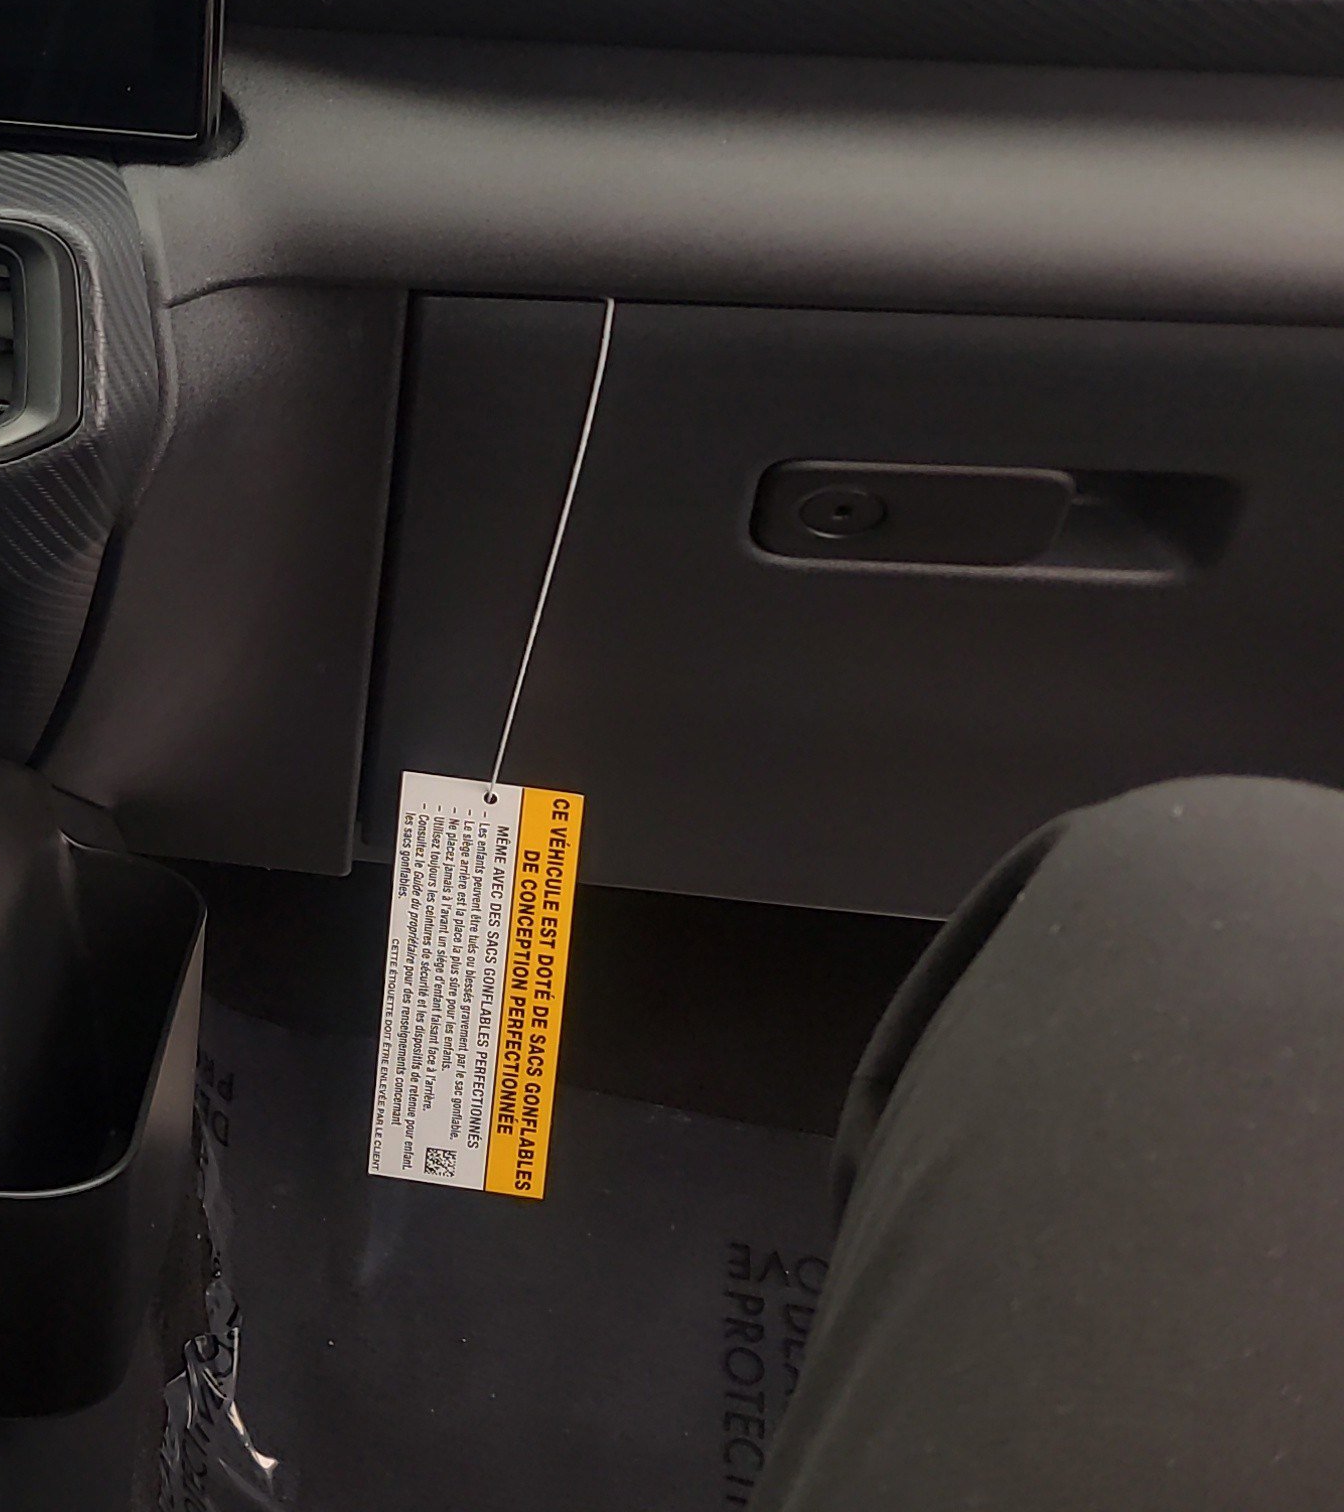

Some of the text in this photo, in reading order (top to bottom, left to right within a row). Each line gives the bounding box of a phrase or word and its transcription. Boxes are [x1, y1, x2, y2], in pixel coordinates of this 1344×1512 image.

[415, 814, 429, 857] Consultez
[431, 816, 444, 849] Utilisez
[459, 833, 473, 857] siège
[477, 822, 490, 838] Les
[397, 812, 416, 898] les sacs gonflables.
[445, 832, 457, 861] placez
[474, 840, 487, 874] enfants
[411, 870, 424, 896] Guide
[427, 851, 441, 887] toujours
[442, 862, 455, 893] jamais
[457, 859, 470, 889] arrière
[426, 889, 438, 902] les
[456, 891, 466, 906] est
[470, 875, 482, 911] peuvent
[422, 904, 435, 945] ceintures
[438, 903, 452, 933] l'avant
[452, 918, 465, 942] place
[469, 914, 481, 932] être
[405, 910, 419, 964] propriétaire
[467, 934, 479, 954] tués
[402, 964, 413, 986] pour
[449, 955, 462, 974] plus
[402, 988, 413, 1003] des
[431, 975, 445, 1011] d'enfant
[462, 969, 476, 1003] blessés
[467, 825, 511, 1148] MÊME AVEC DES SACS GONFLABLES PERFECTIONNÉS
[496, 849, 540, 1135] DE CONCEPTION PERFECTIONNÉE
[514, 798, 570, 1190] CE VÉHICULE EST DOTÉ DE SACS GONFLABLES
[415, 1009, 427, 1022] les
[445, 998, 456, 1019] pour
[395, 1005, 410, 1075] renseignements
[428, 1014, 442, 1044] faisant
[444, 1021, 456, 1034] les
[458, 1004, 470, 1051] gravement
[411, 1025, 425, 1069] dispositifs
[426, 1046, 439, 1065] face
[441, 1036, 454, 1071] enfants.
[455, 1052, 465, 1068] par
[390, 1077, 403, 1125] concernant
[407, 1084, 418, 1117] retenue
[453, 1080, 463, 1095] sac
[404, 1118, 414, 1139] pour
[449, 1097, 462, 1139] gonflable.
[402, 1140, 413, 1170] enfant.
